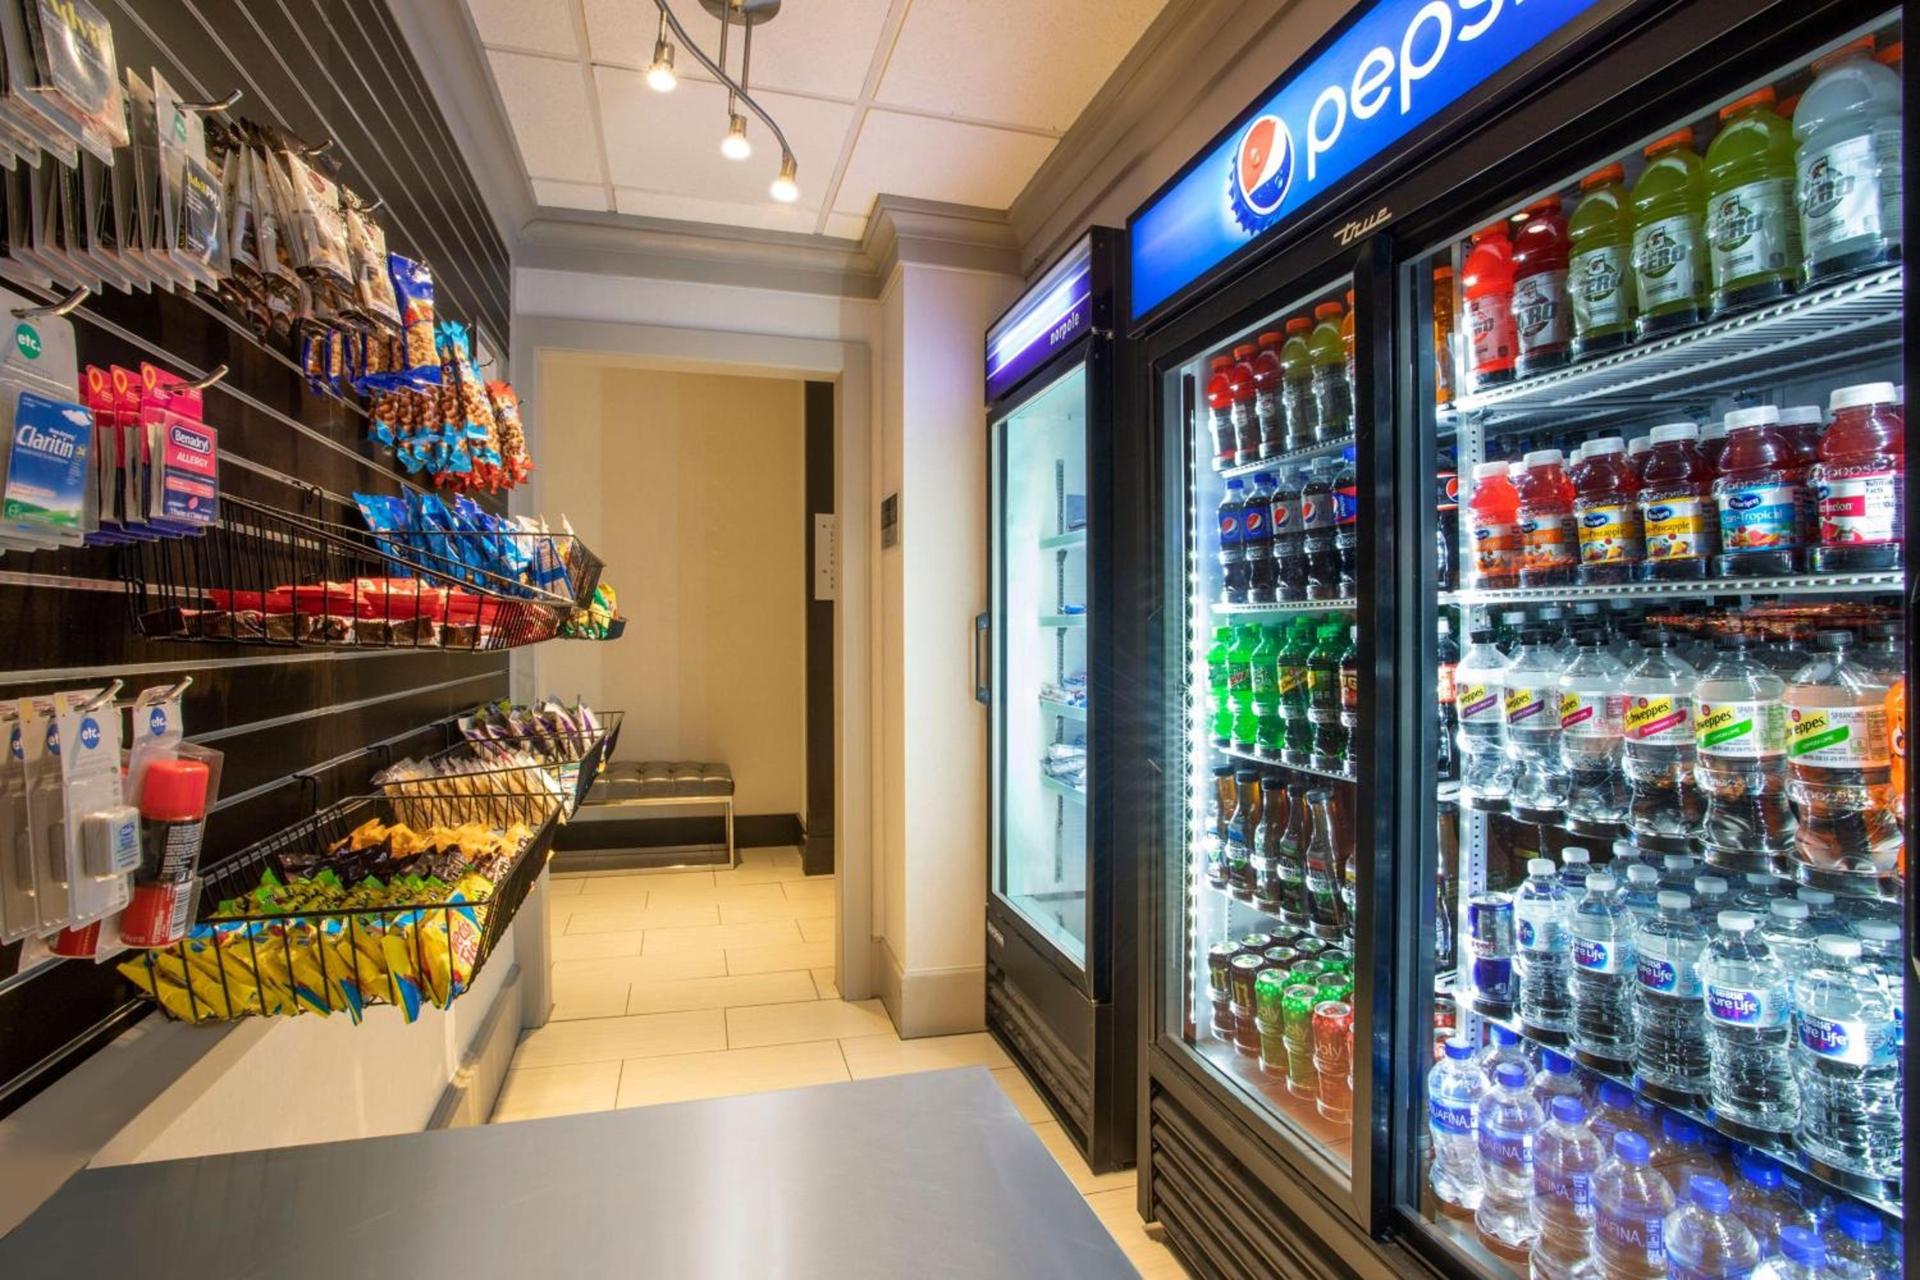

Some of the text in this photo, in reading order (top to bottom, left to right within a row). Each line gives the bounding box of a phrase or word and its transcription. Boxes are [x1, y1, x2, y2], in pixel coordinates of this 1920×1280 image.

[1307, 0, 1523, 182] peps
[1333, 206, 1393, 246] true
[17, 333, 42, 352] etc.
[16, 424, 74, 458] Claritin
[174, 428, 210, 451] Benadryl
[176, 451, 209, 468] ALLERGY
[151, 717, 168, 728] etc.
[48, 734, 60, 746] et
[81, 726, 102, 740] etc.
[1588, 947, 1606, 962] Life
[1652, 969, 1673, 982] Life
[1733, 999, 1758, 1015] Life
[1820, 1030, 1847, 1048] Life
